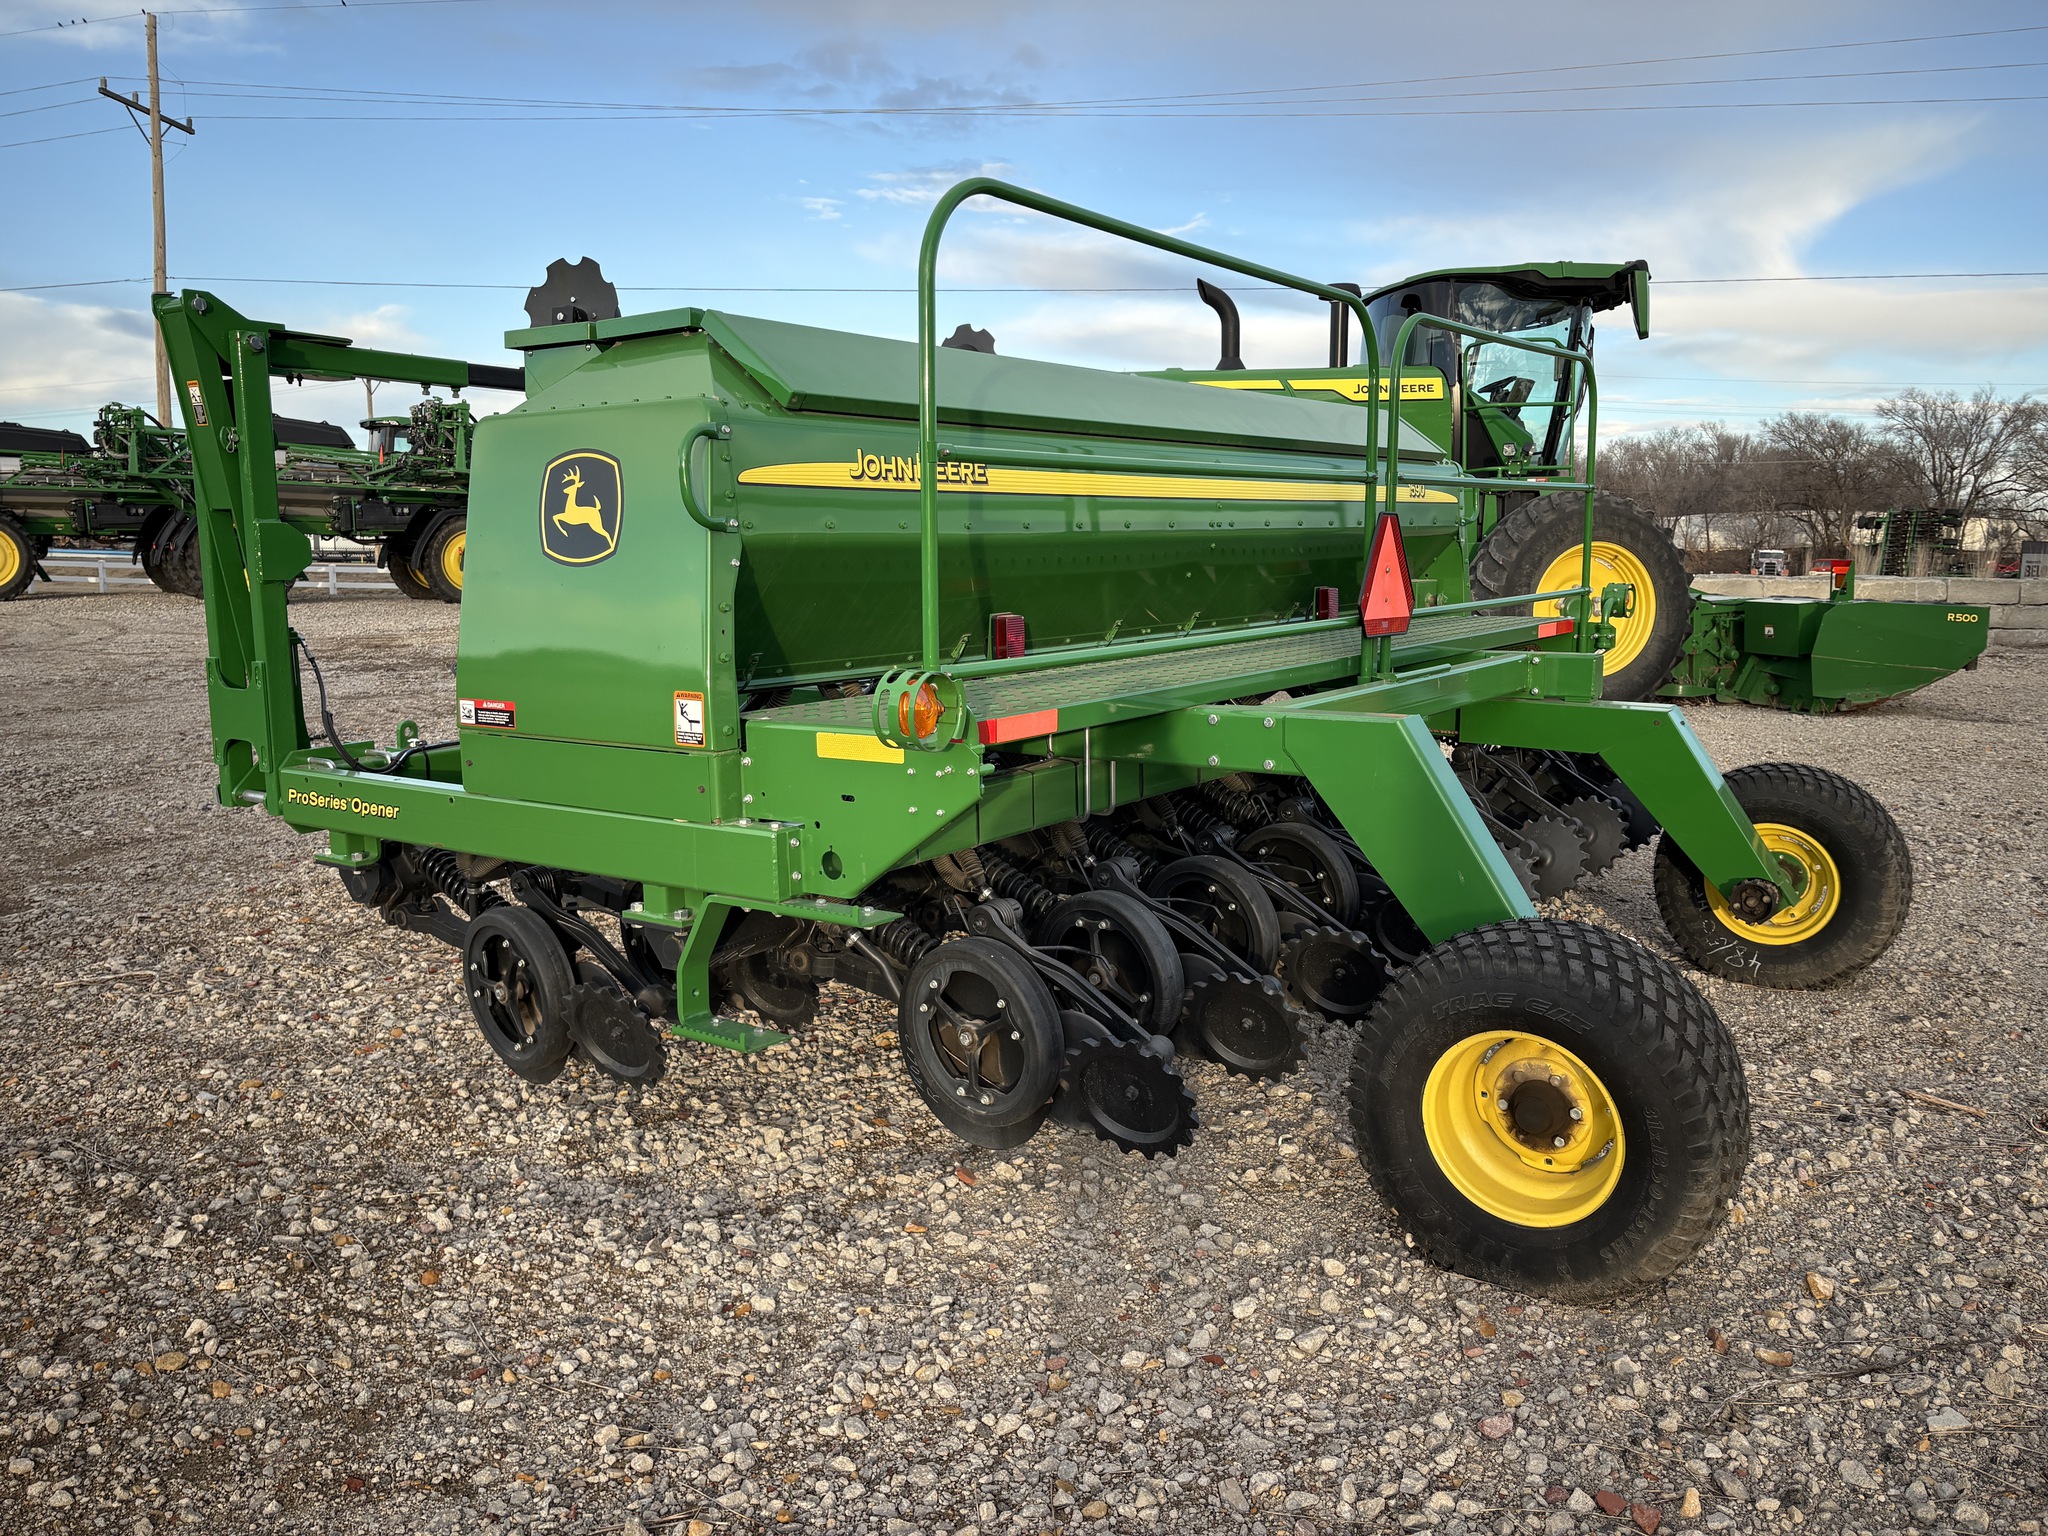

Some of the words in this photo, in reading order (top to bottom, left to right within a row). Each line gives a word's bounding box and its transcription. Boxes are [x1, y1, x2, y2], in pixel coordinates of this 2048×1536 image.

[1354, 384, 1388, 394] JON
[1400, 384, 1435, 393] EERE
[850, 448, 914, 482] JOHN
[1947, 613, 1979, 623] R500
[680, 692, 702, 700] WARNING
[486, 701, 506, 709] DANGER
[351, 797, 400, 819] Opener
[1432, 992, 1517, 1020] TRAC
